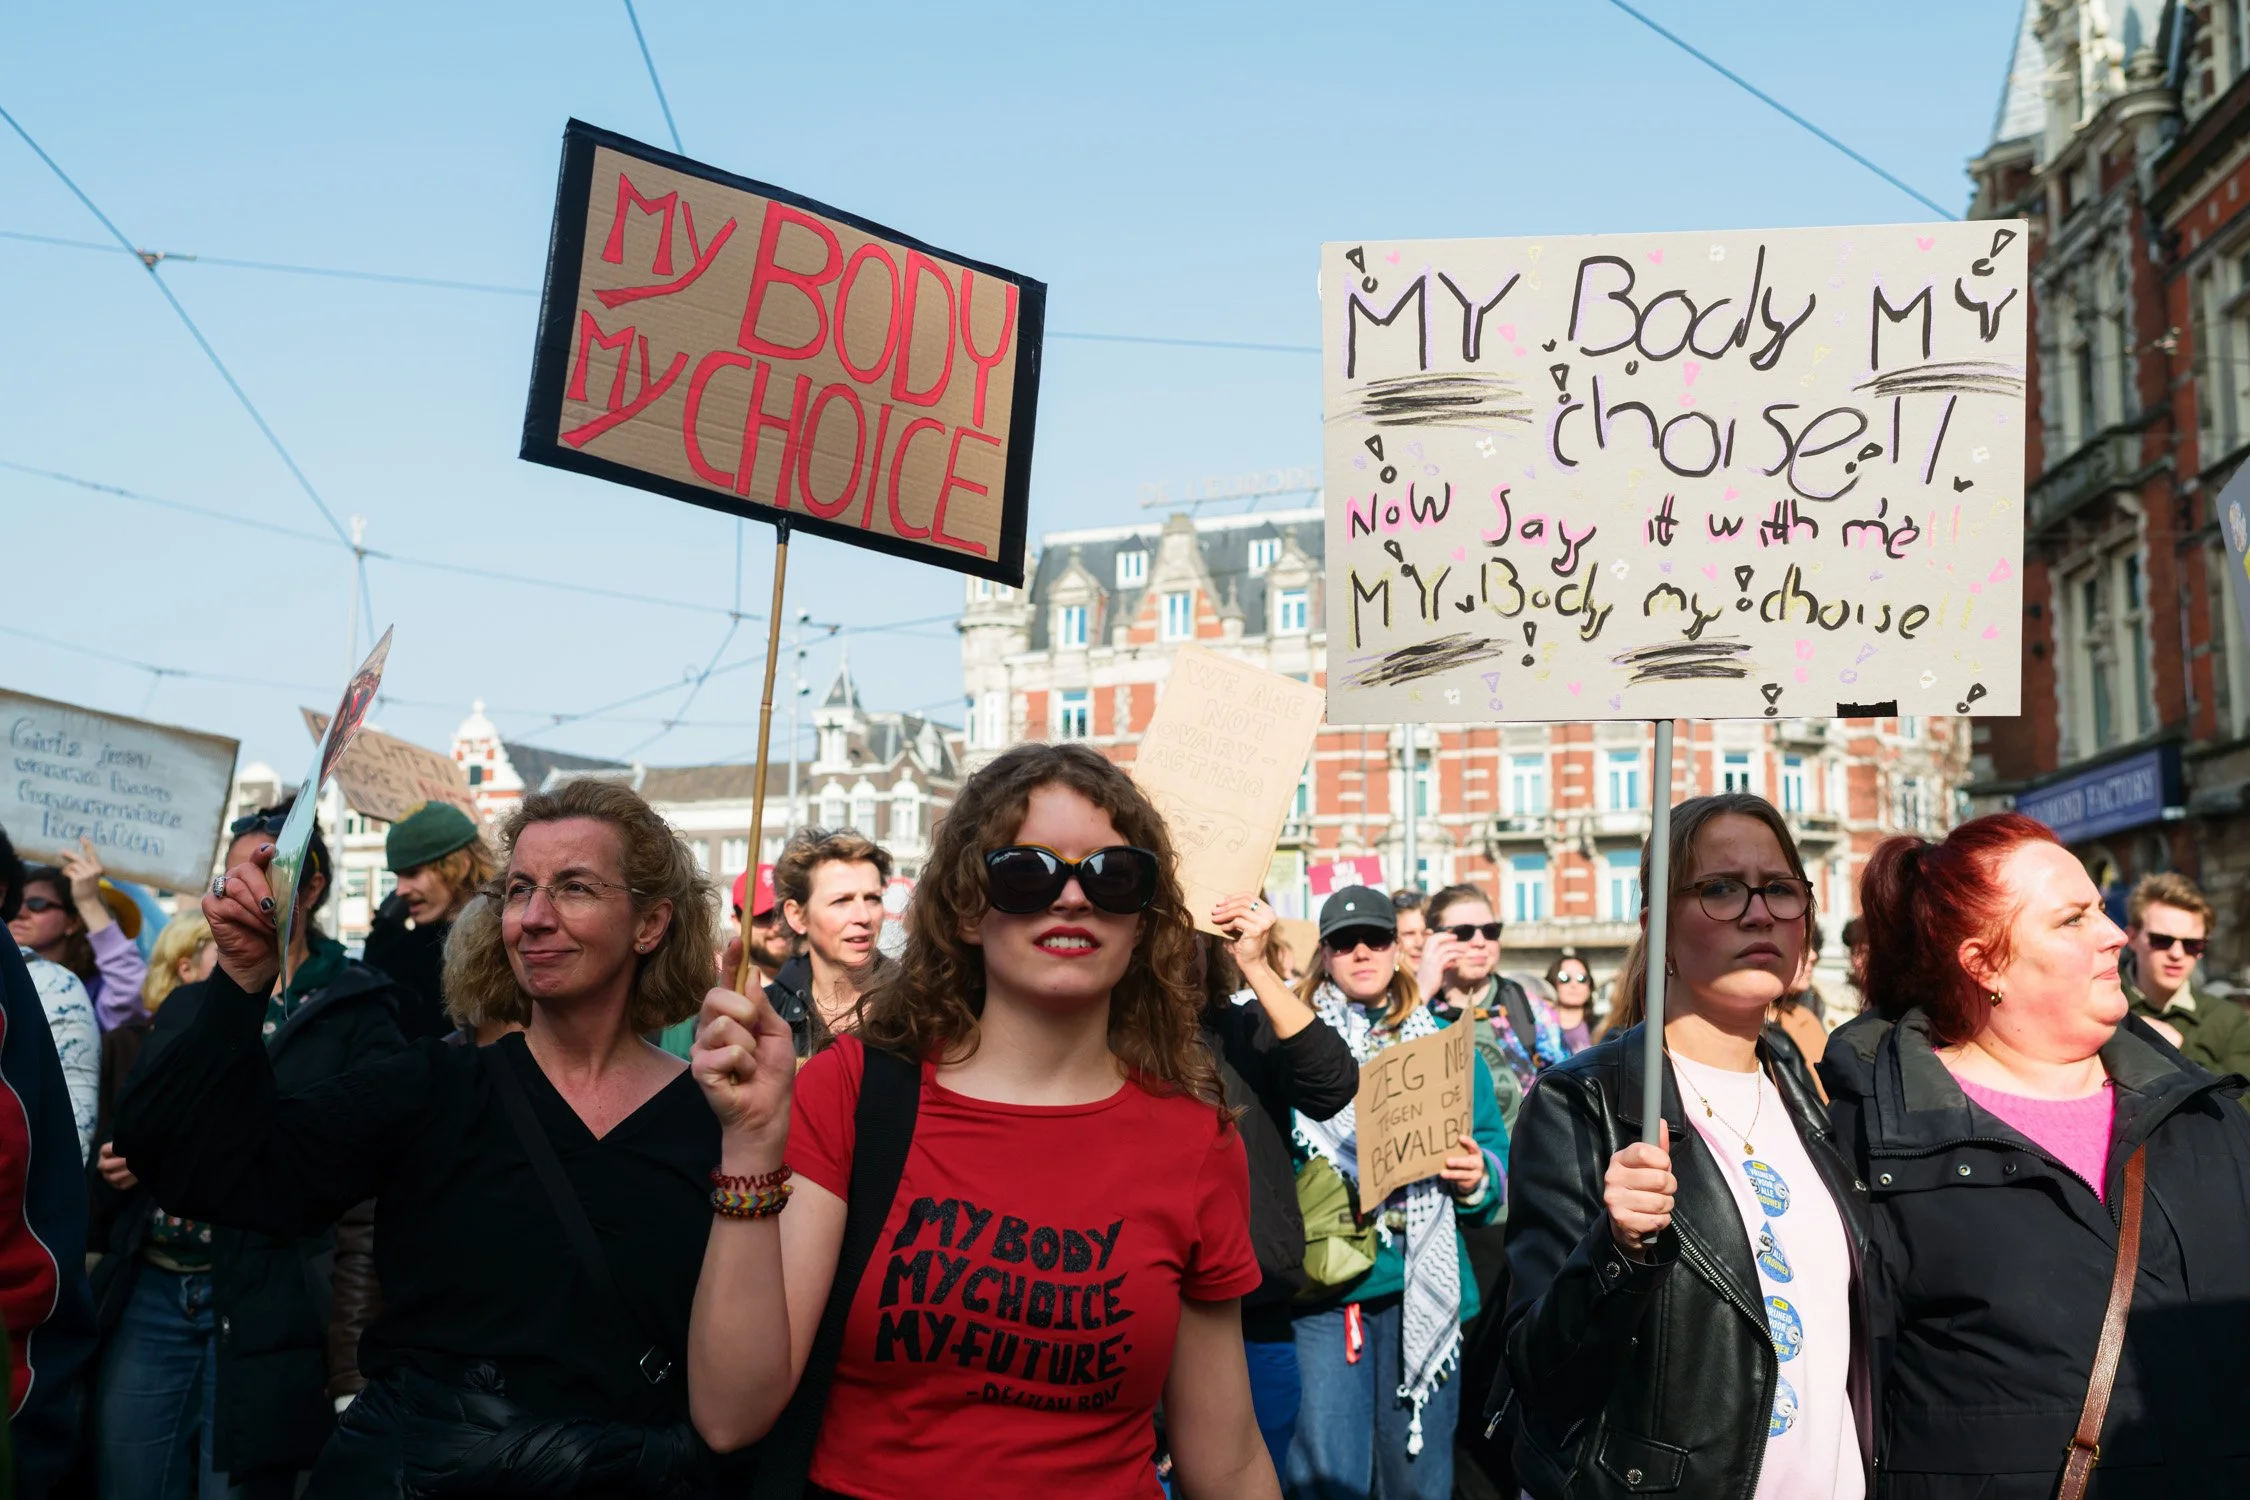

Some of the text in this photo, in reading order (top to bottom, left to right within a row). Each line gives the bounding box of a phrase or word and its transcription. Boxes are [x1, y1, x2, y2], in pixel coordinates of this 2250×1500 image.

[593, 172, 1019, 428] MY BODY
[1345, 244, 2018, 379] MY Body MY
[560, 309, 1002, 556] MY CHOICE
[1481, 484, 1597, 577] Say
[1644, 493, 1679, 546] it
[1349, 563, 1451, 650] MY
[1482, 557, 1613, 641] Body
[1644, 583, 1723, 640] my
[1186, 658, 1306, 720] WE ARE
[1201, 698, 1277, 742] NOT
[1369, 1053, 1424, 1114] ZEG
[1377, 1103, 1424, 1138] TEGEN
[889, 1197, 1125, 1273] MY BODY
[878, 1250, 1136, 1330] MY CHOICE
[875, 1309, 1128, 1386] MY FUTURE
[1771, 1330, 1783, 1342] LLE
